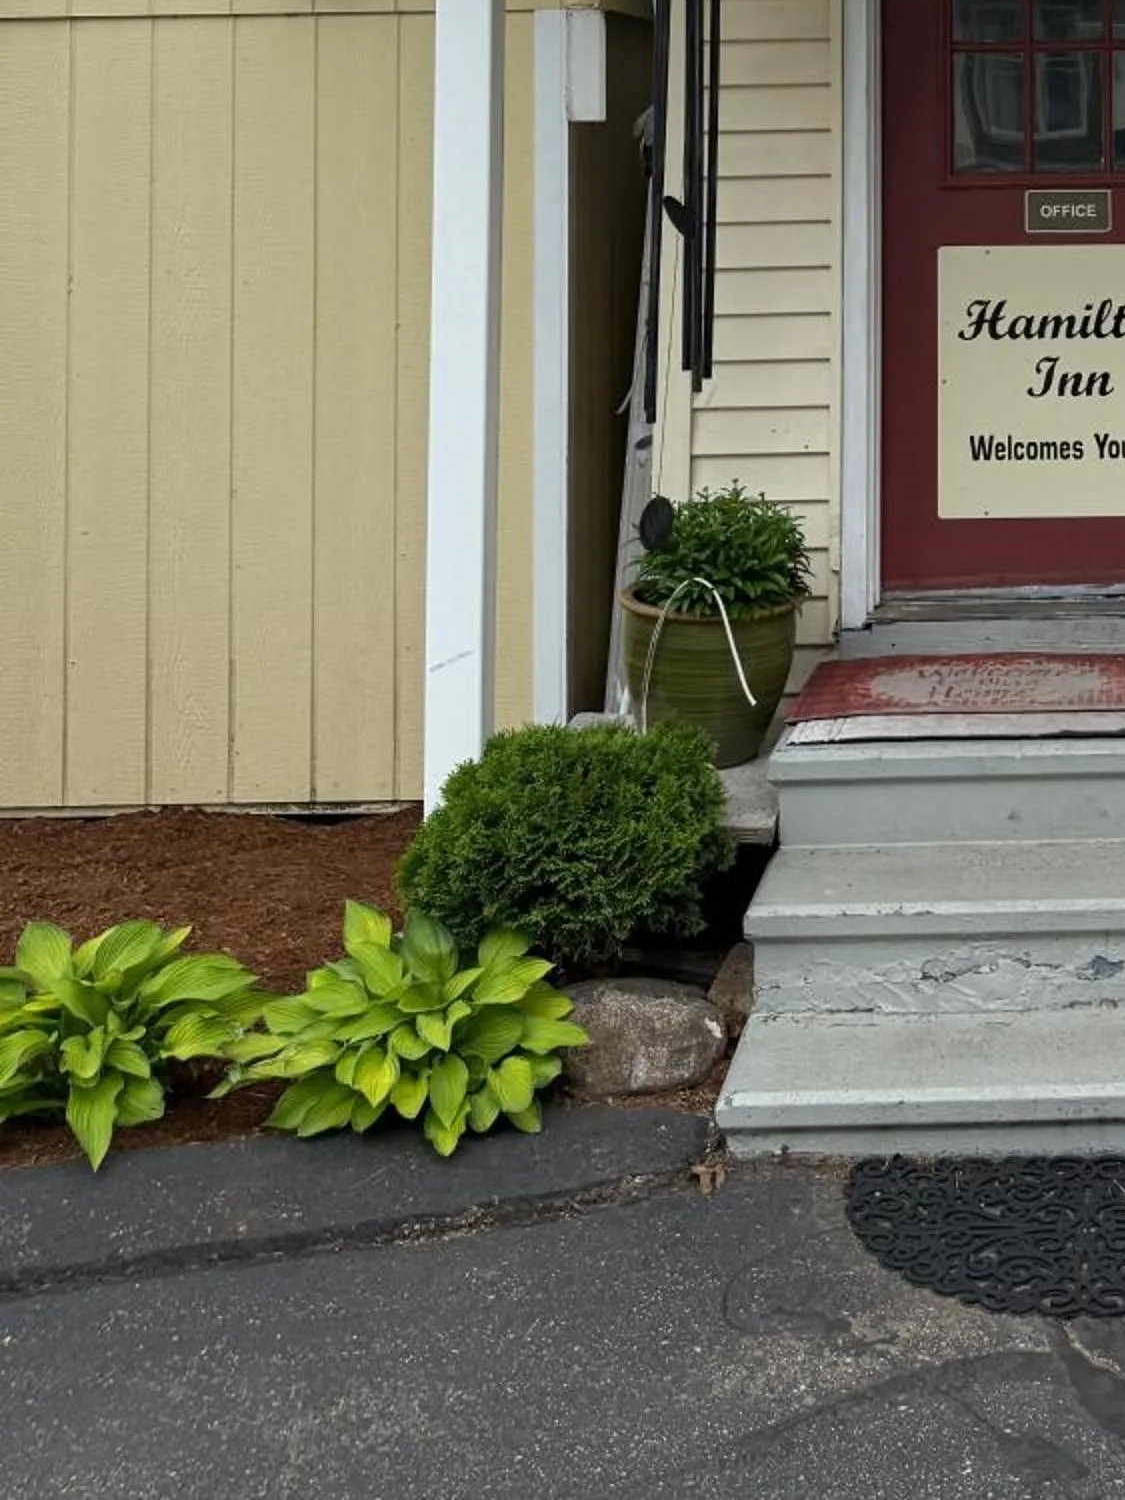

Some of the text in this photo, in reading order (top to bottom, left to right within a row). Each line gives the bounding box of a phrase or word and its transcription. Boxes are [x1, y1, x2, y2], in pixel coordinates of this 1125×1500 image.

[1040, 204, 1097, 218] OFFICE
[1026, 355, 1114, 397] Inn
[969, 435, 1084, 461] Welcomes
